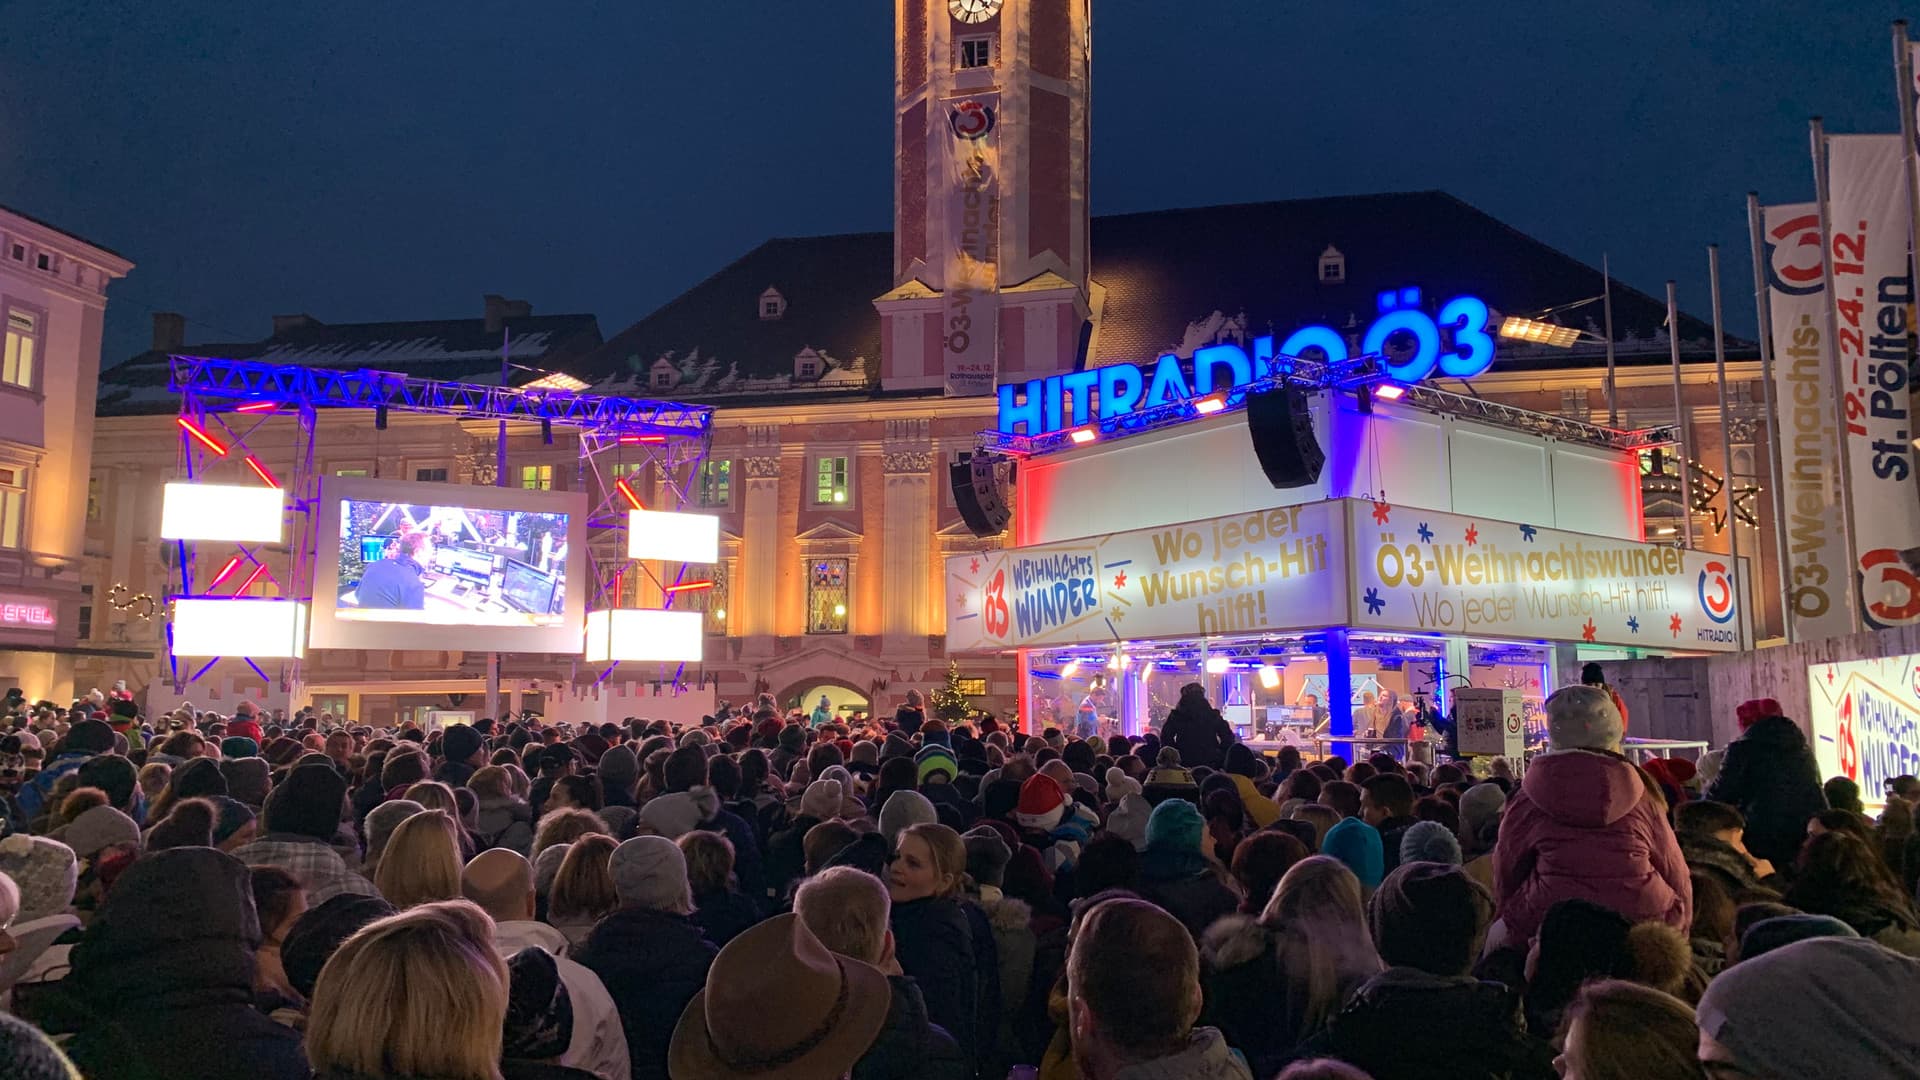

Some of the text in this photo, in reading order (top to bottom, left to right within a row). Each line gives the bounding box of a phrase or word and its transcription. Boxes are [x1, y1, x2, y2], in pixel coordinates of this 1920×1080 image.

[998, 286, 1496, 438] HITRADIO Ö3
[1868, 275, 1913, 482] St. Pölten
[1152, 505, 1303, 566] Wo jeder
[1376, 533, 1686, 588] Ö3-Weihnachtswunder
[1012, 553, 1094, 591] WEIHNACHTS
[1140, 533, 1328, 608] Wunsch-Hit
[985, 568, 1010, 638] Ö3
[1015, 578, 1097, 638] WUNDER
[1197, 589, 1268, 637] hilft!
[1411, 579, 1670, 633] Wo jeder Wunsch-Hit hilft!
[1697, 628, 1733, 643] HITRADIO
[1839, 693, 1857, 781] Ö3
[1858, 689, 1920, 750] WEIHNACHTS
